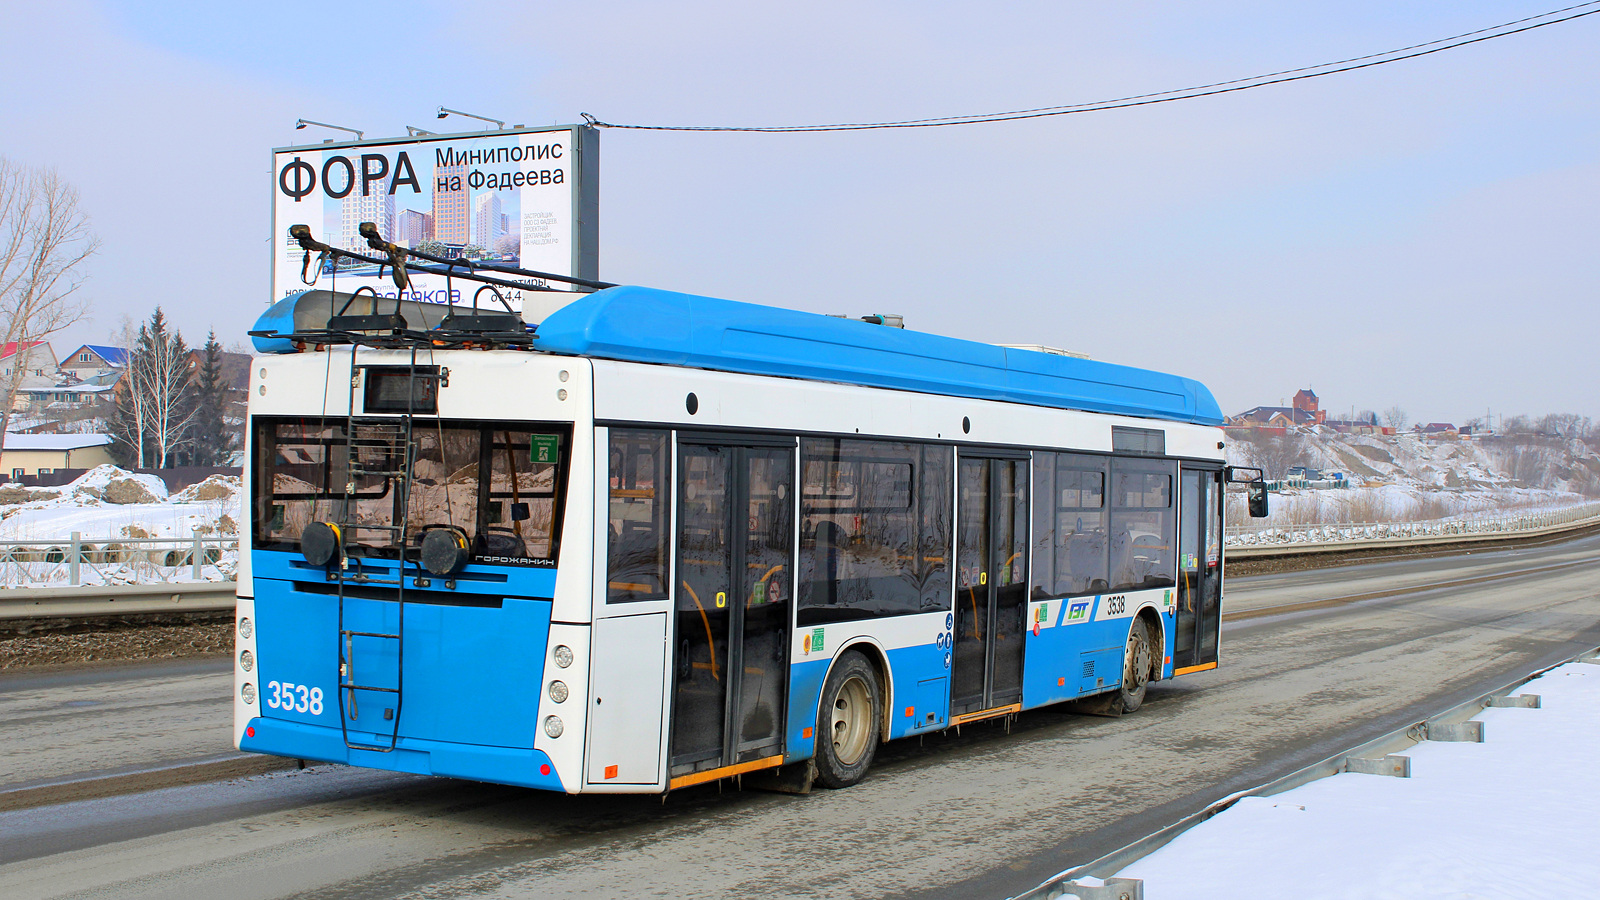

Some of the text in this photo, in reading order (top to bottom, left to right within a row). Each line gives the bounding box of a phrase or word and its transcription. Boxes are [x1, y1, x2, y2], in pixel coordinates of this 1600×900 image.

[435, 143, 563, 168] Миниполис
[279, 151, 422, 202] ФОРА
[437, 168, 565, 192] на Фадеева
[475, 555, 555, 565] ГОРОЖАНИН
[1107, 595, 1125, 615] 3538
[267, 680, 324, 715] 3538
